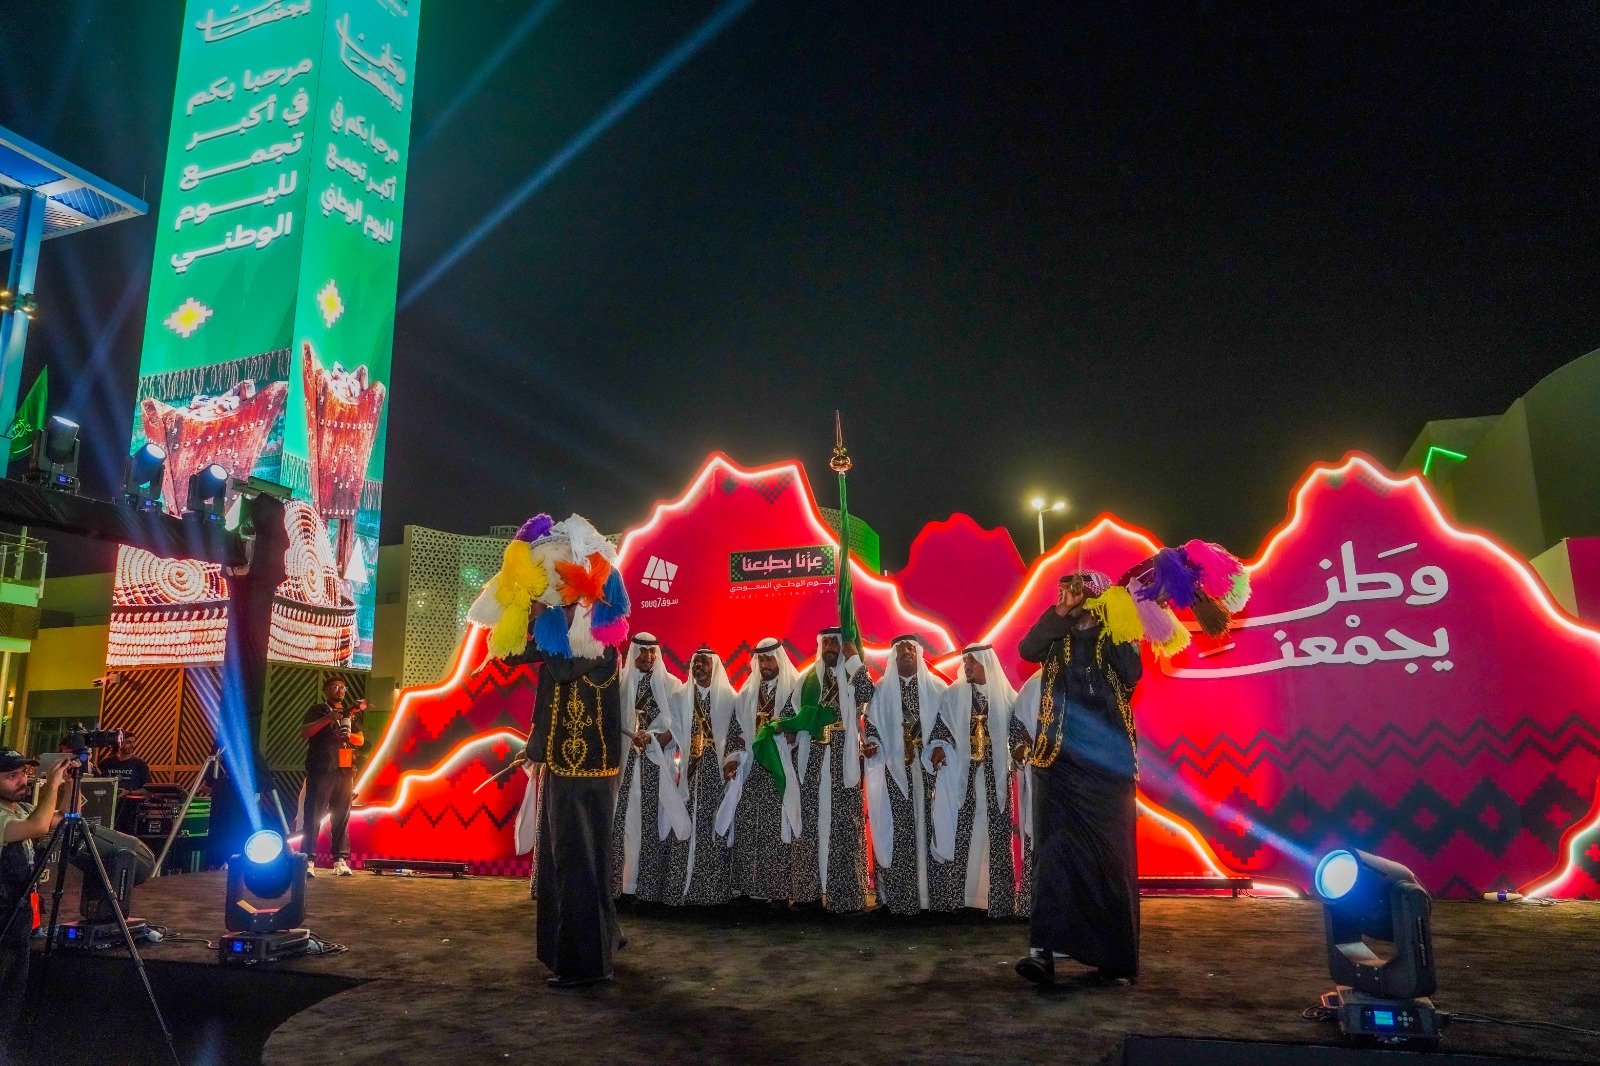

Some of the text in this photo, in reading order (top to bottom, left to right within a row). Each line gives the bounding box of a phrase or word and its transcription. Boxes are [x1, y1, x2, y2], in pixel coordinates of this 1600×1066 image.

[186, 59, 312, 115] مرحبا بكم
[282, 88, 310, 126] في
[331, 95, 399, 164] مرحبا بكم في
[180, 132, 304, 190] تجمع
[174, 170, 297, 231] لليوم
[171, 212, 292, 272] الوطني
[364, 214, 394, 244] لليوم
[730, 578, 836, 594] اليوم الوطني السعودي
[742, 554, 792, 575] بطبعنا
